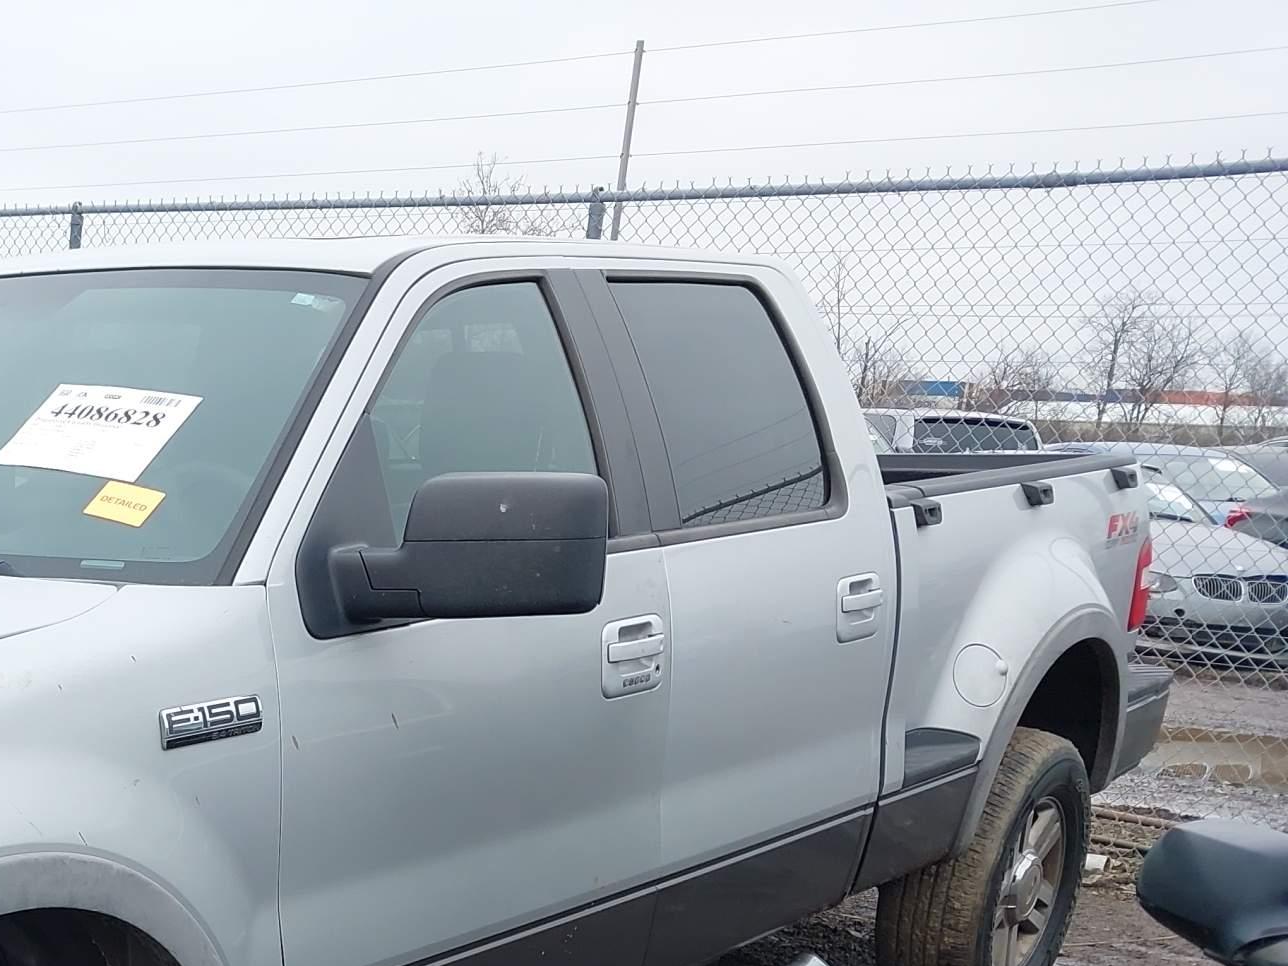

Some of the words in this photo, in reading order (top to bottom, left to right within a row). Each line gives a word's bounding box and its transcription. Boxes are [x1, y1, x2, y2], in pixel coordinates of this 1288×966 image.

[51, 403, 166, 428] 44086828
[100, 495, 147, 512] DETAILED
[166, 697, 261, 735] F-150
